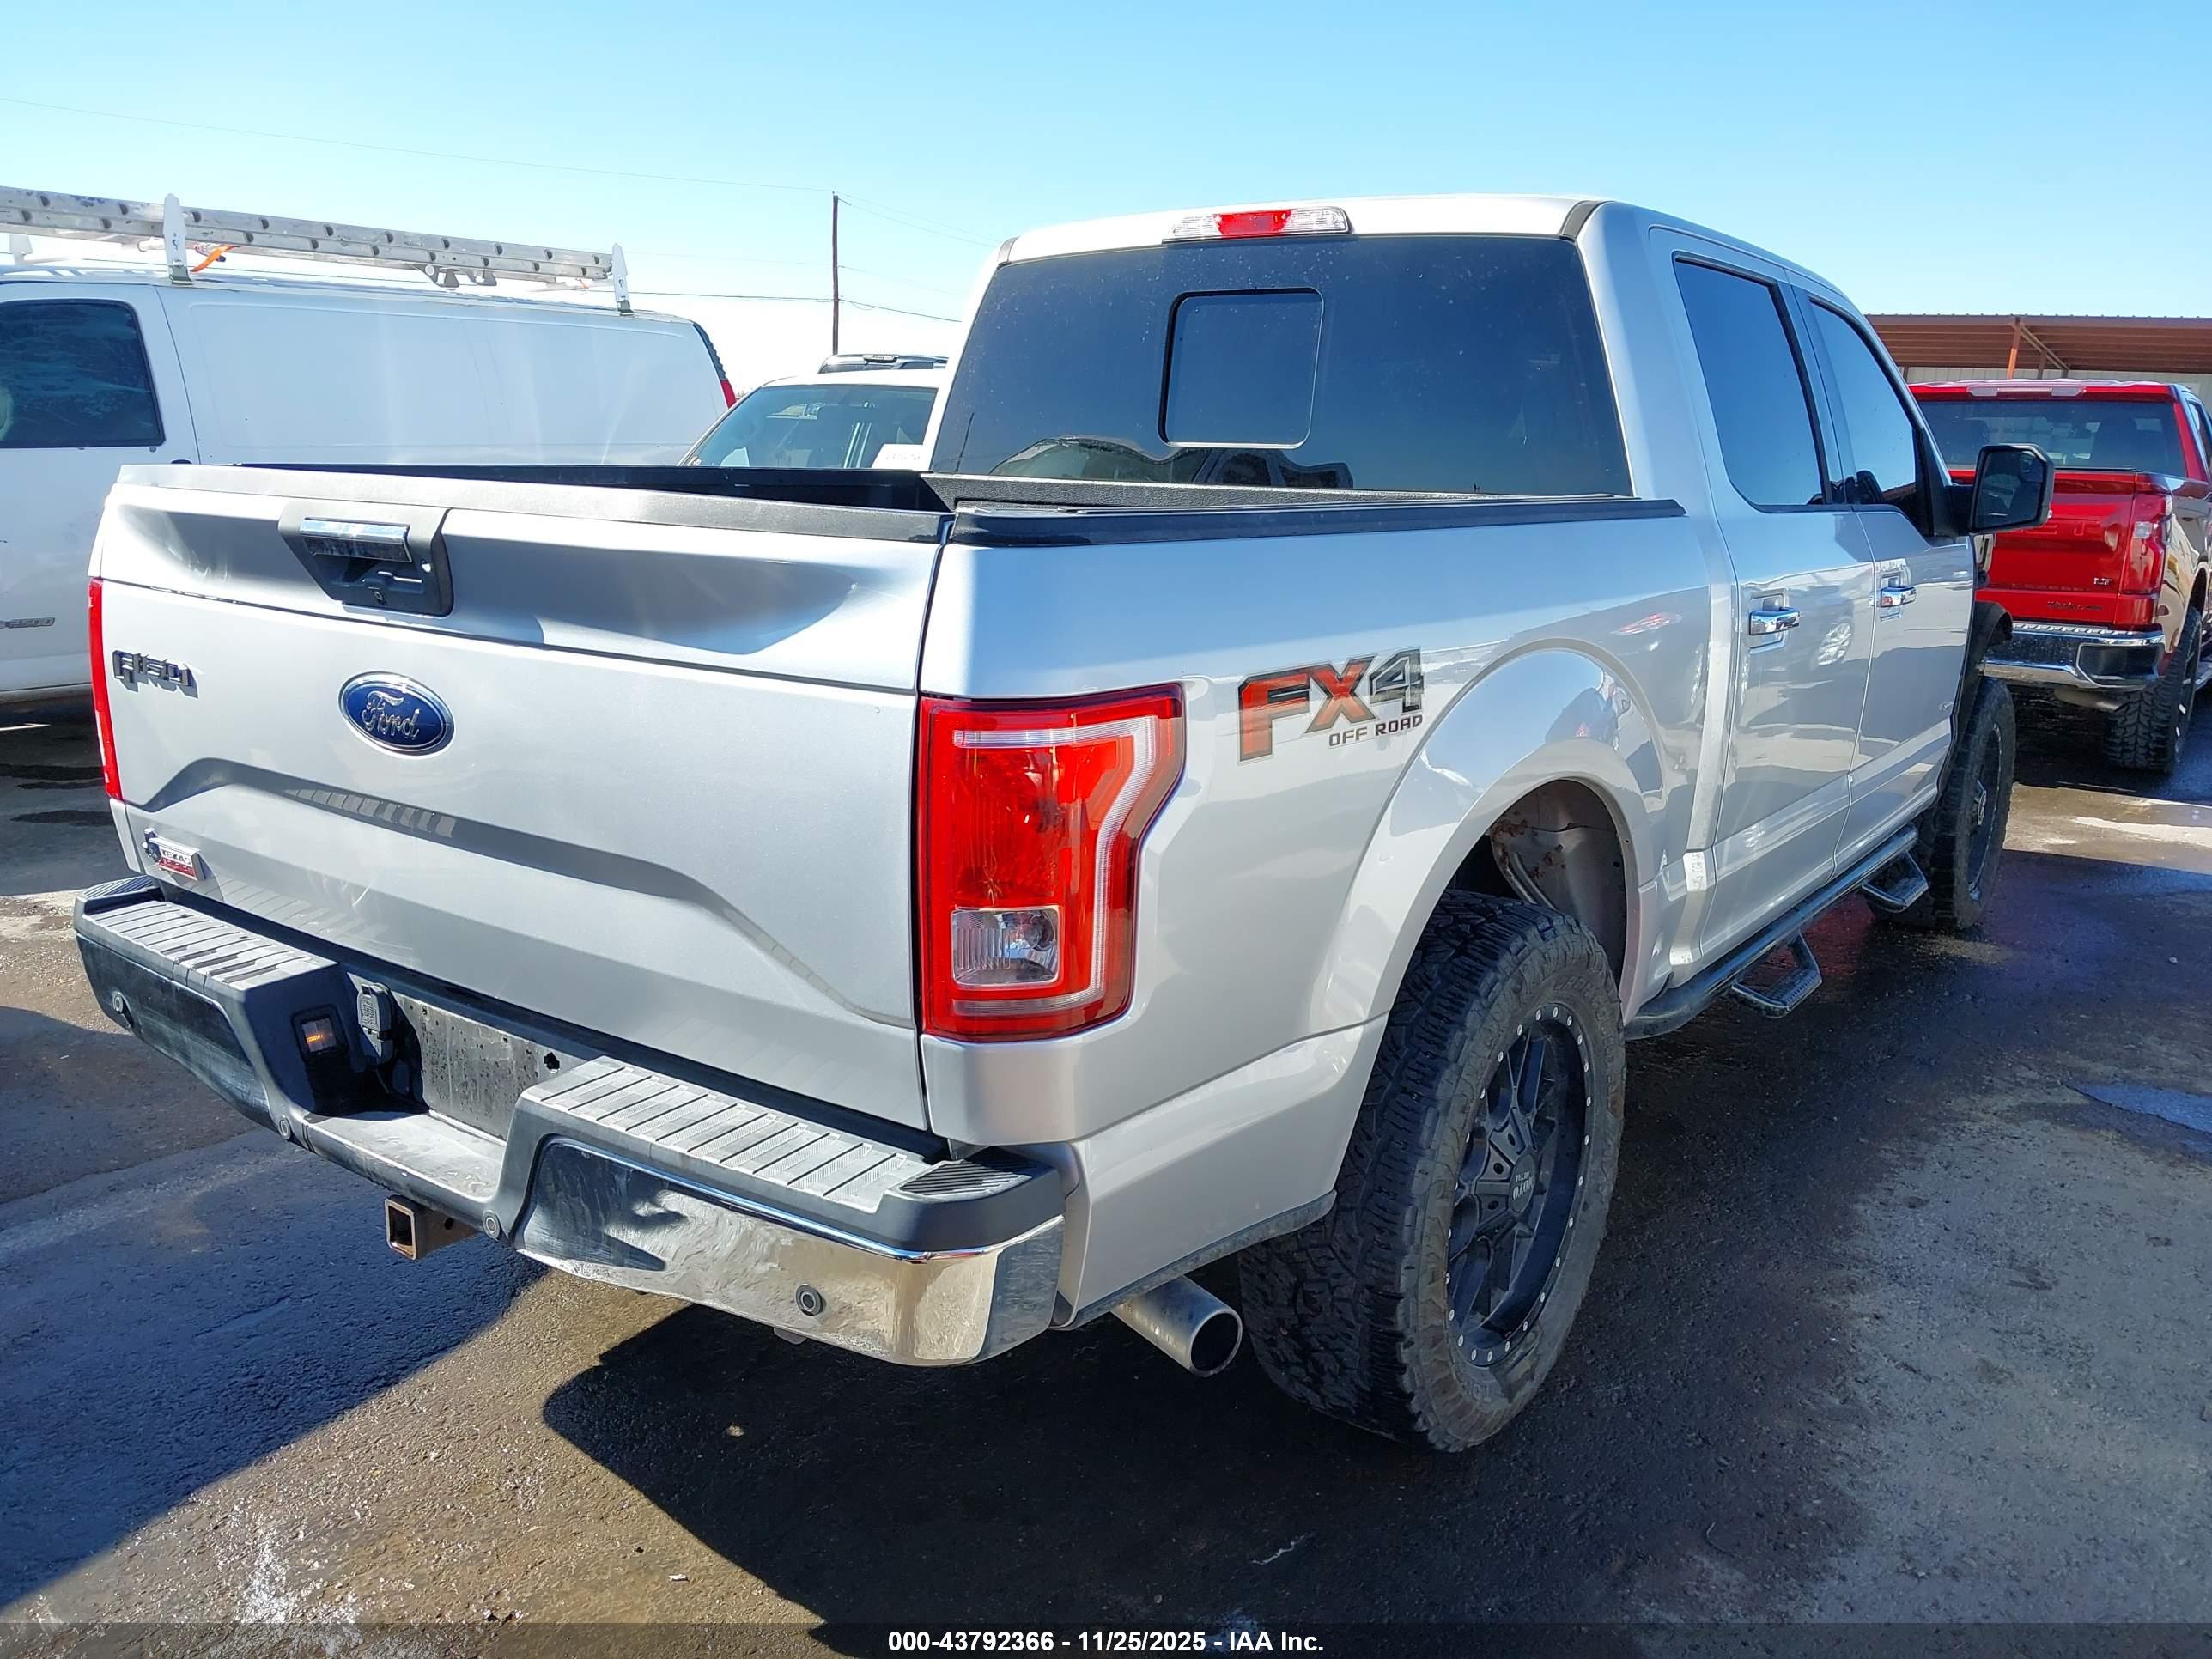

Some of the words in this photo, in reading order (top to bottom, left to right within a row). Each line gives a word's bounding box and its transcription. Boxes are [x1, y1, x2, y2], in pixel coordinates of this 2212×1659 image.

[362, 690, 419, 739] Ford
[1239, 647, 1425, 763] FX4
[1329, 727, 1367, 747] OFF
[1375, 714, 1424, 736] ROAD
